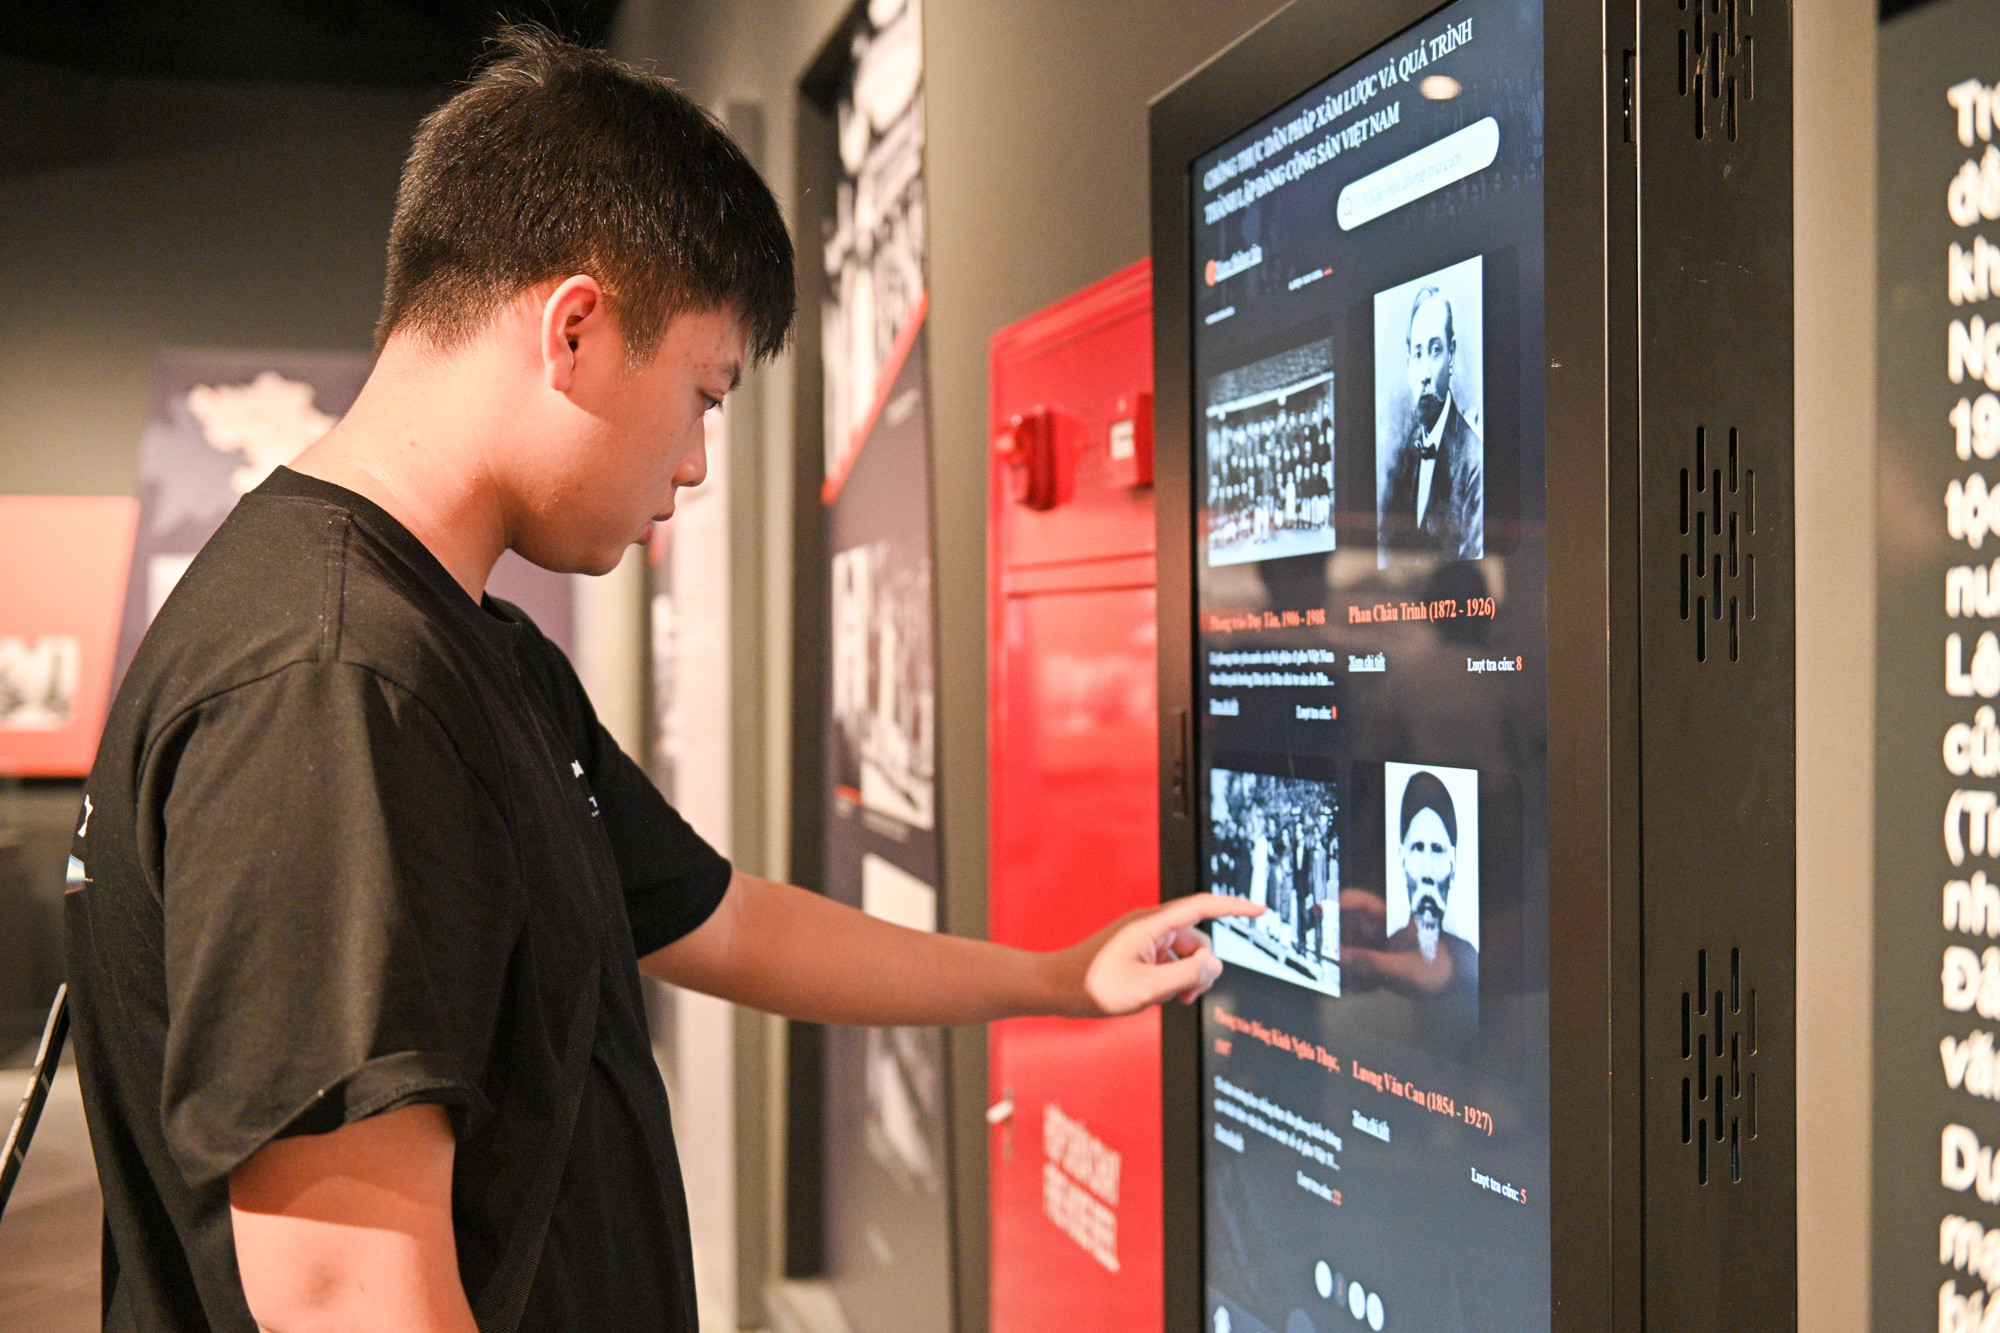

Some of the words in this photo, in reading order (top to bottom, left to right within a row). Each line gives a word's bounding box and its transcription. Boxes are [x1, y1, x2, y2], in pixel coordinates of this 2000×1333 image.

[1315, 94, 1343, 128] XÂM
[1344, 74, 1377, 112] LƯỢC
[1378, 57, 1398, 89] VÀ
[1398, 39, 1428, 82] QUÁ
[1429, 17, 1473, 62] TRÌNH
[1316, 133, 1340, 164] SẢN
[1340, 118, 1369, 150] VIỆT
[1369, 101, 1400, 137] NAM
[1348, 606, 1372, 624] Phan
[1373, 603, 1398, 622] Châu
[1400, 602, 1427, 621] Trinh
[1428, 600, 1456, 622] (1872
[1466, 597, 1496, 619] 1926)
[1467, 658, 1486, 673] Lượt
[1486, 659, 1497, 671] tra
[1516, 656, 1523, 671] 8
[1352, 1061, 1383, 1092] Lương
[1383, 1073, 1402, 1096] Văn
[1404, 1083, 1425, 1106] Can
[1426, 1092, 1454, 1117] (1854
[1464, 1106, 1493, 1136] 1927)
[1470, 1167, 1489, 1189] Lượt
[1490, 1178, 1501, 1193] tra
[1520, 1189, 1526, 1204] 5
